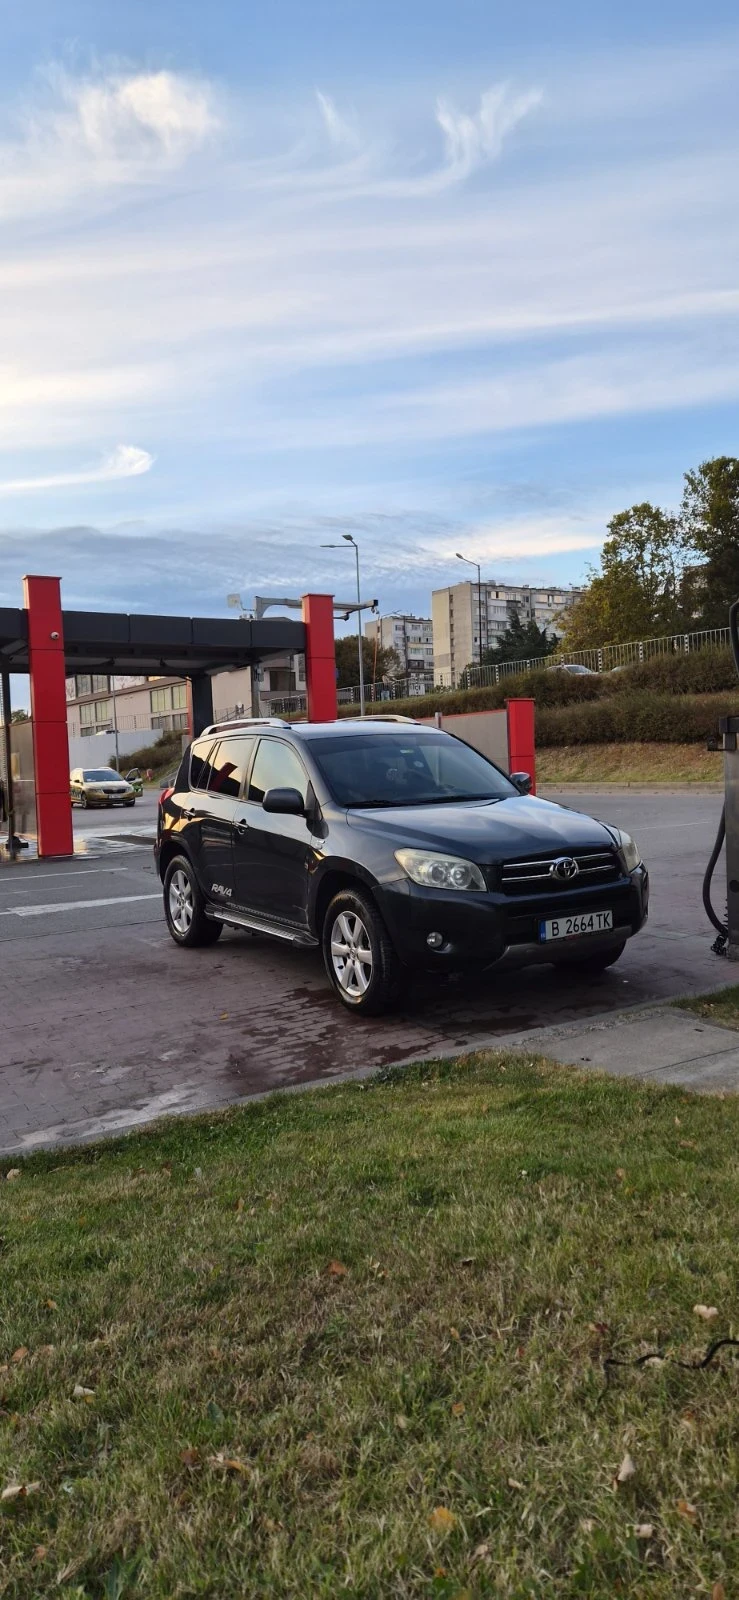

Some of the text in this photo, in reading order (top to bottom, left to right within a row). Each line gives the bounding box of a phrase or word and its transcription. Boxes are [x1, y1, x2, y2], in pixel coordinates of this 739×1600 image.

[211, 883, 232, 897] RAV4
[551, 921, 559, 936] B
[566, 915, 594, 934] 2664
[596, 912, 610, 928] TK
